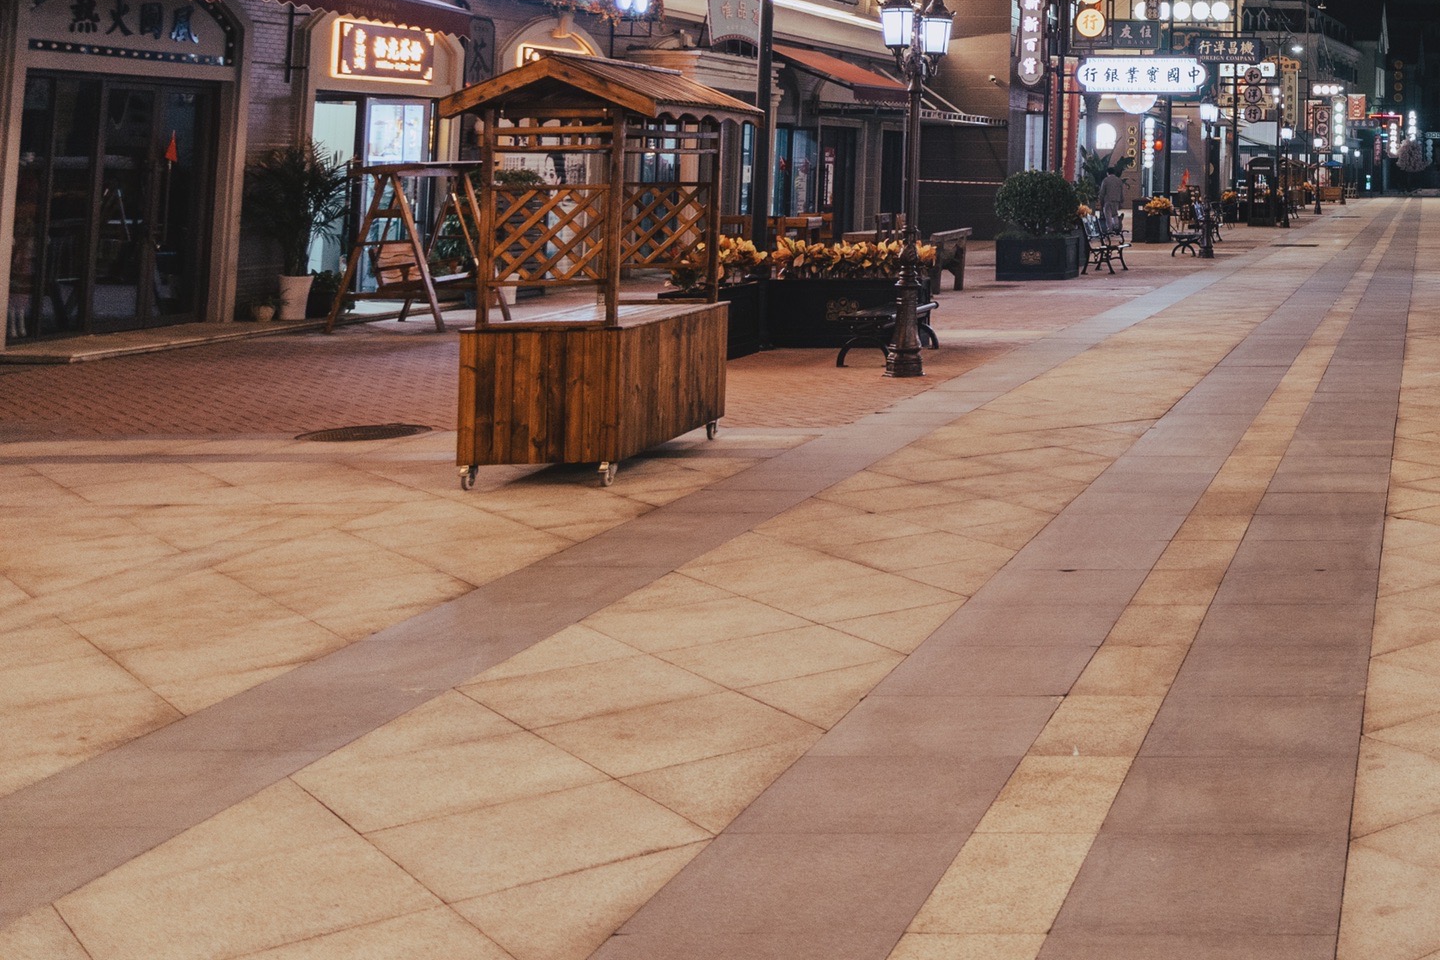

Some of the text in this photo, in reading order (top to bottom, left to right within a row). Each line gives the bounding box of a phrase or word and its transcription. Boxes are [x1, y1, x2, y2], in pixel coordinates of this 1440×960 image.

[1083, 65, 1201, 84] 中國實業銀行
